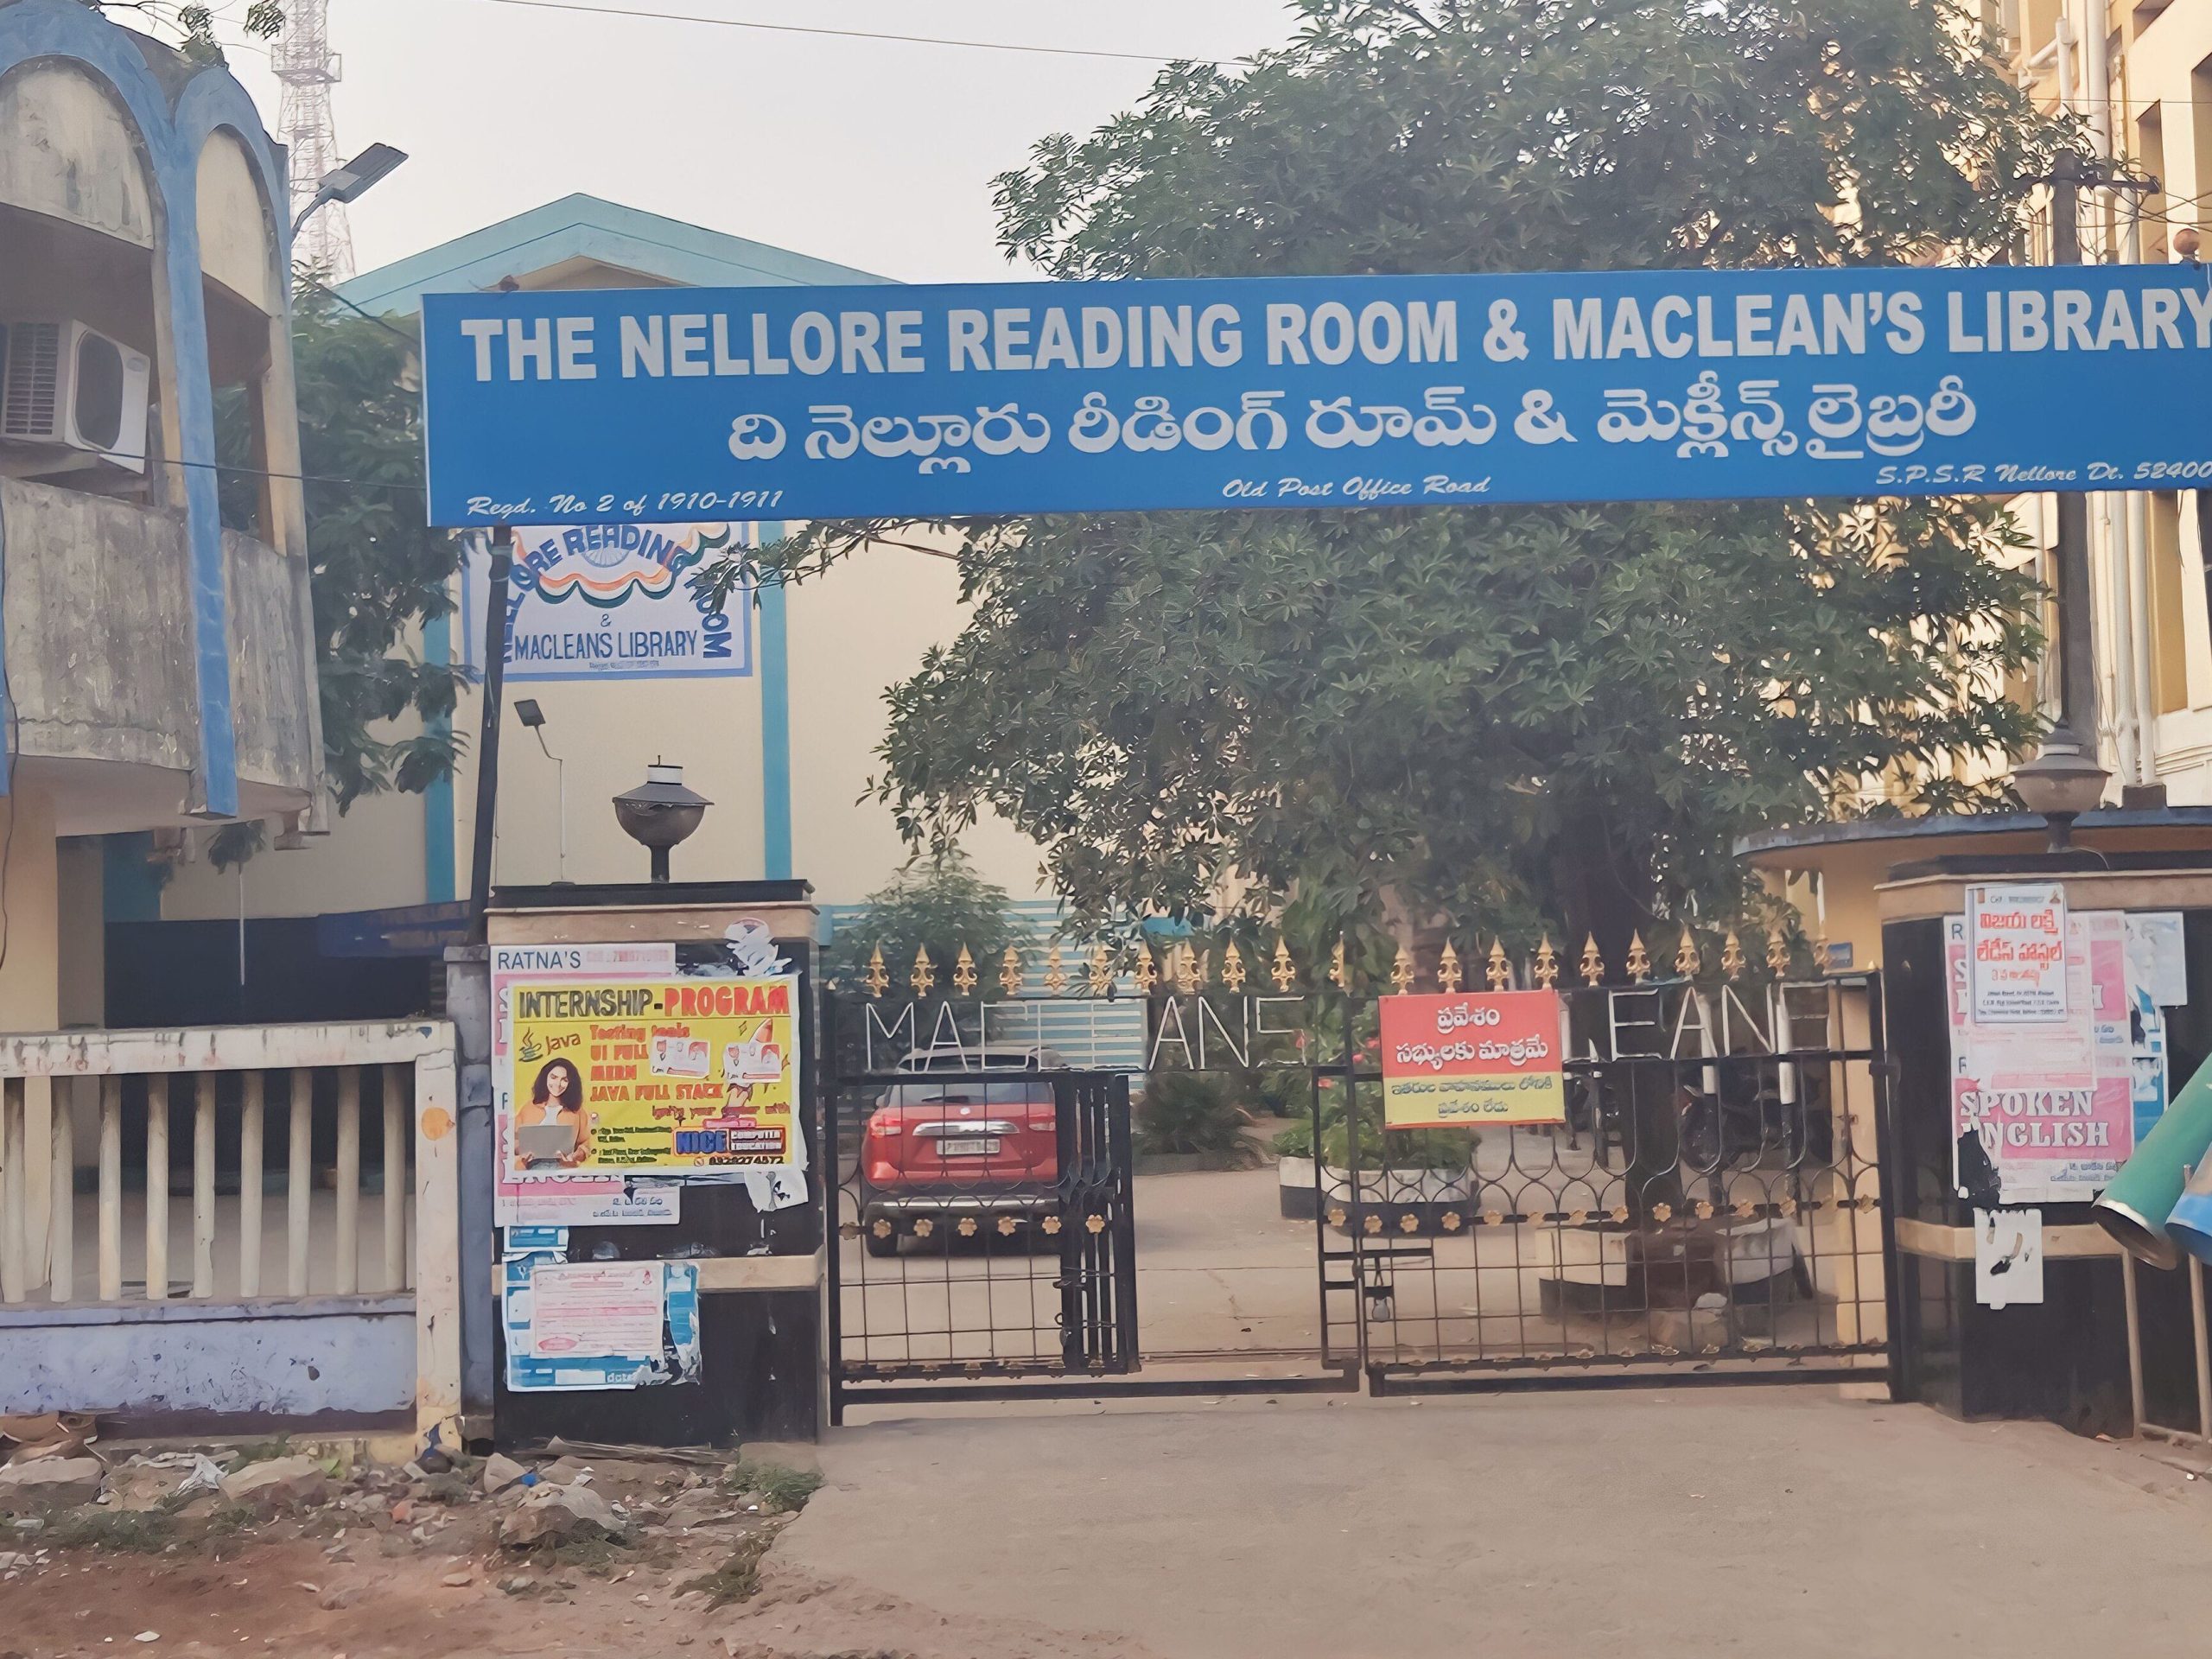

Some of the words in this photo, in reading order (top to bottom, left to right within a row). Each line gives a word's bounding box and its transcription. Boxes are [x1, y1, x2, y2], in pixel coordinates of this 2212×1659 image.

[461, 316, 597, 382] THE
[620, 310, 925, 378] NELLORE
[947, 303, 1243, 372] READING
[1266, 300, 1458, 365] ROOM
[1483, 298, 1530, 363] &
[1552, 290, 1925, 360] MACLEAN'S
[1948, 287, 2212, 353] LIBRARY
[728, 414, 786, 461] ది
[804, 402, 1052, 474] నెల్లూరు
[1068, 390, 1288, 454] రీడింగ్
[1305, 385, 1497, 449] రూమ్
[1513, 389, 1579, 445] &
[1597, 370, 1799, 459] మెక్లీన్స్
[1805, 374, 1977, 460] లైబ్రరీ
[1222, 479, 1268, 498] Old
[1277, 477, 1334, 498] Post
[1342, 476, 1413, 501] Office
[1422, 474, 1491, 495] Road
[1876, 464, 1986, 485] S.P.S.R
[1994, 463, 2076, 483] Nellore
[467, 496, 536, 518] Regd.
[549, 494, 588, 514] No
[595, 494, 615, 512] 2
[623, 494, 647, 517] of
[658, 490, 784, 511] 1910-1911
[514, 631, 613, 661] MACLEANS
[617, 629, 698, 658] LIBRARY
[498, 950, 582, 970] RATNA'S
[1437, 1001, 1501, 1034] ప్రవేశం
[545, 1033, 582, 1056] Java
[1395, 1041, 1476, 1071] సభ్యులకు
[1478, 1033, 1549, 1066] మాత్రమే
[1960, 1090, 2094, 1117] SPOKEN
